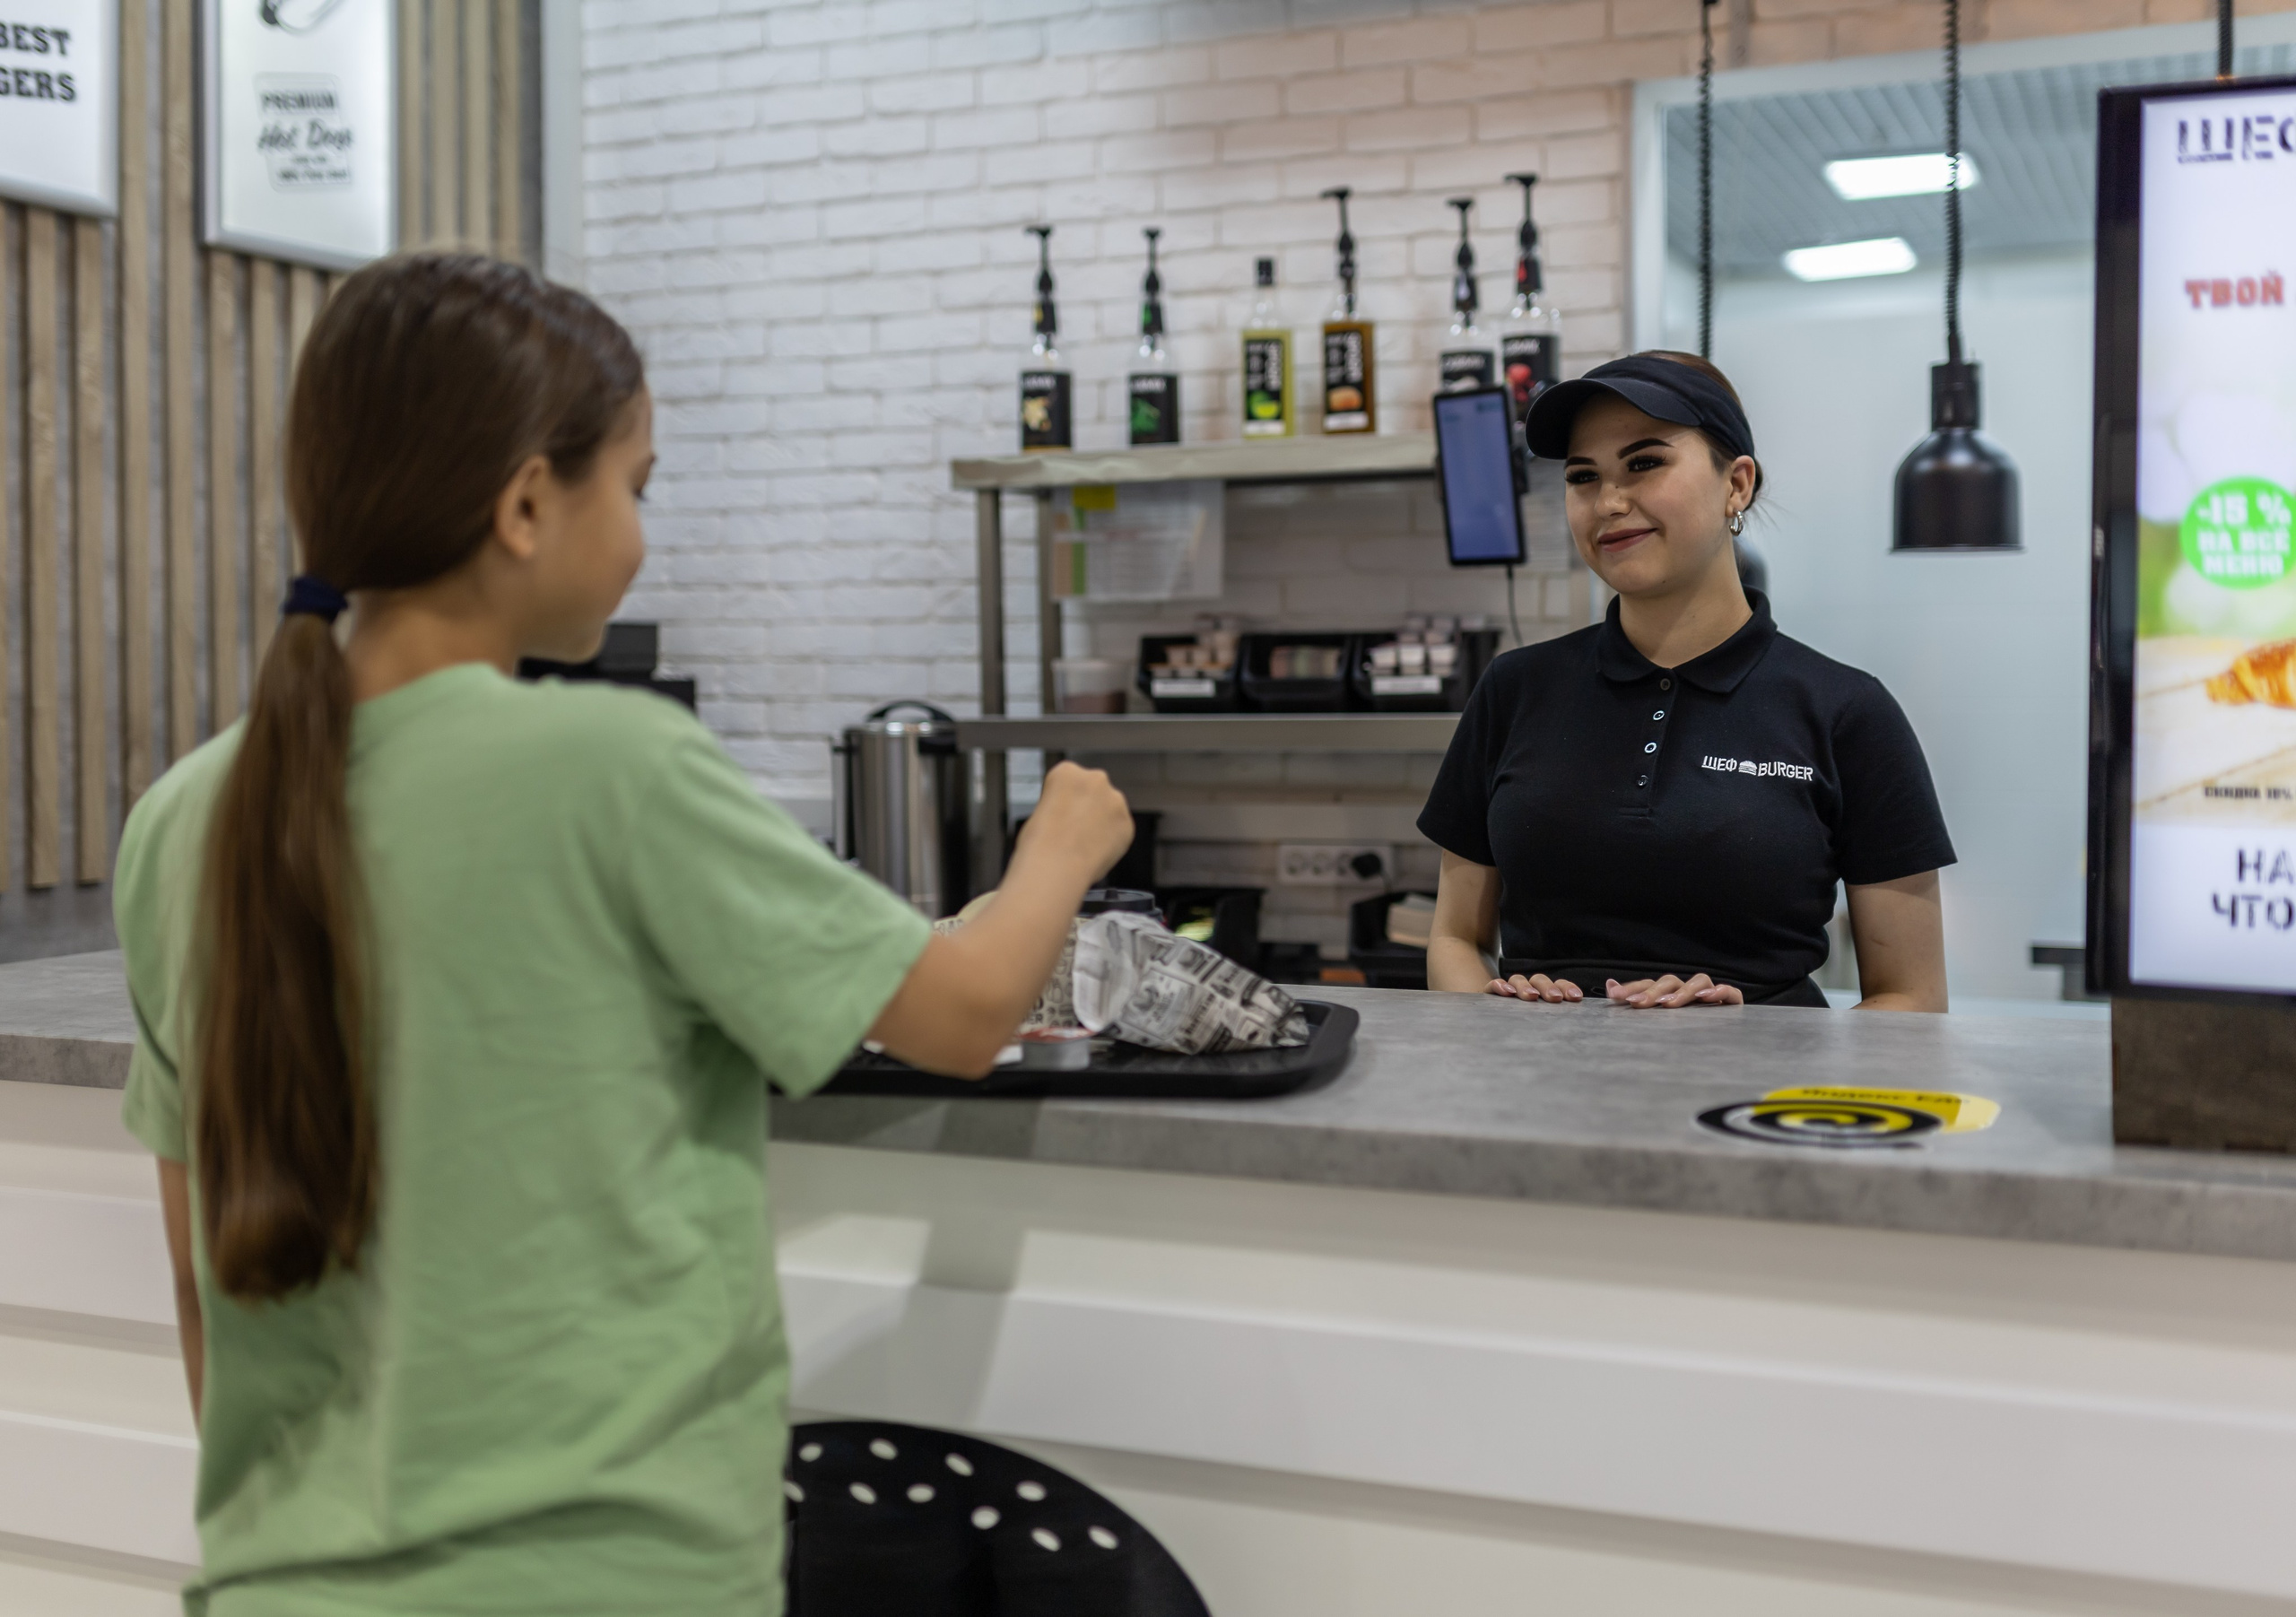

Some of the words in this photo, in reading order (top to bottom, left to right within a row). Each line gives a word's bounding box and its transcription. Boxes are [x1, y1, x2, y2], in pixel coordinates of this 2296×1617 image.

[261, 91, 335, 110] PREMIUM
[2184, 269, 2284, 309] ТВОЙ
[1701, 755, 1738, 772] ШЕФ
[1757, 761, 1813, 782] BURGER
